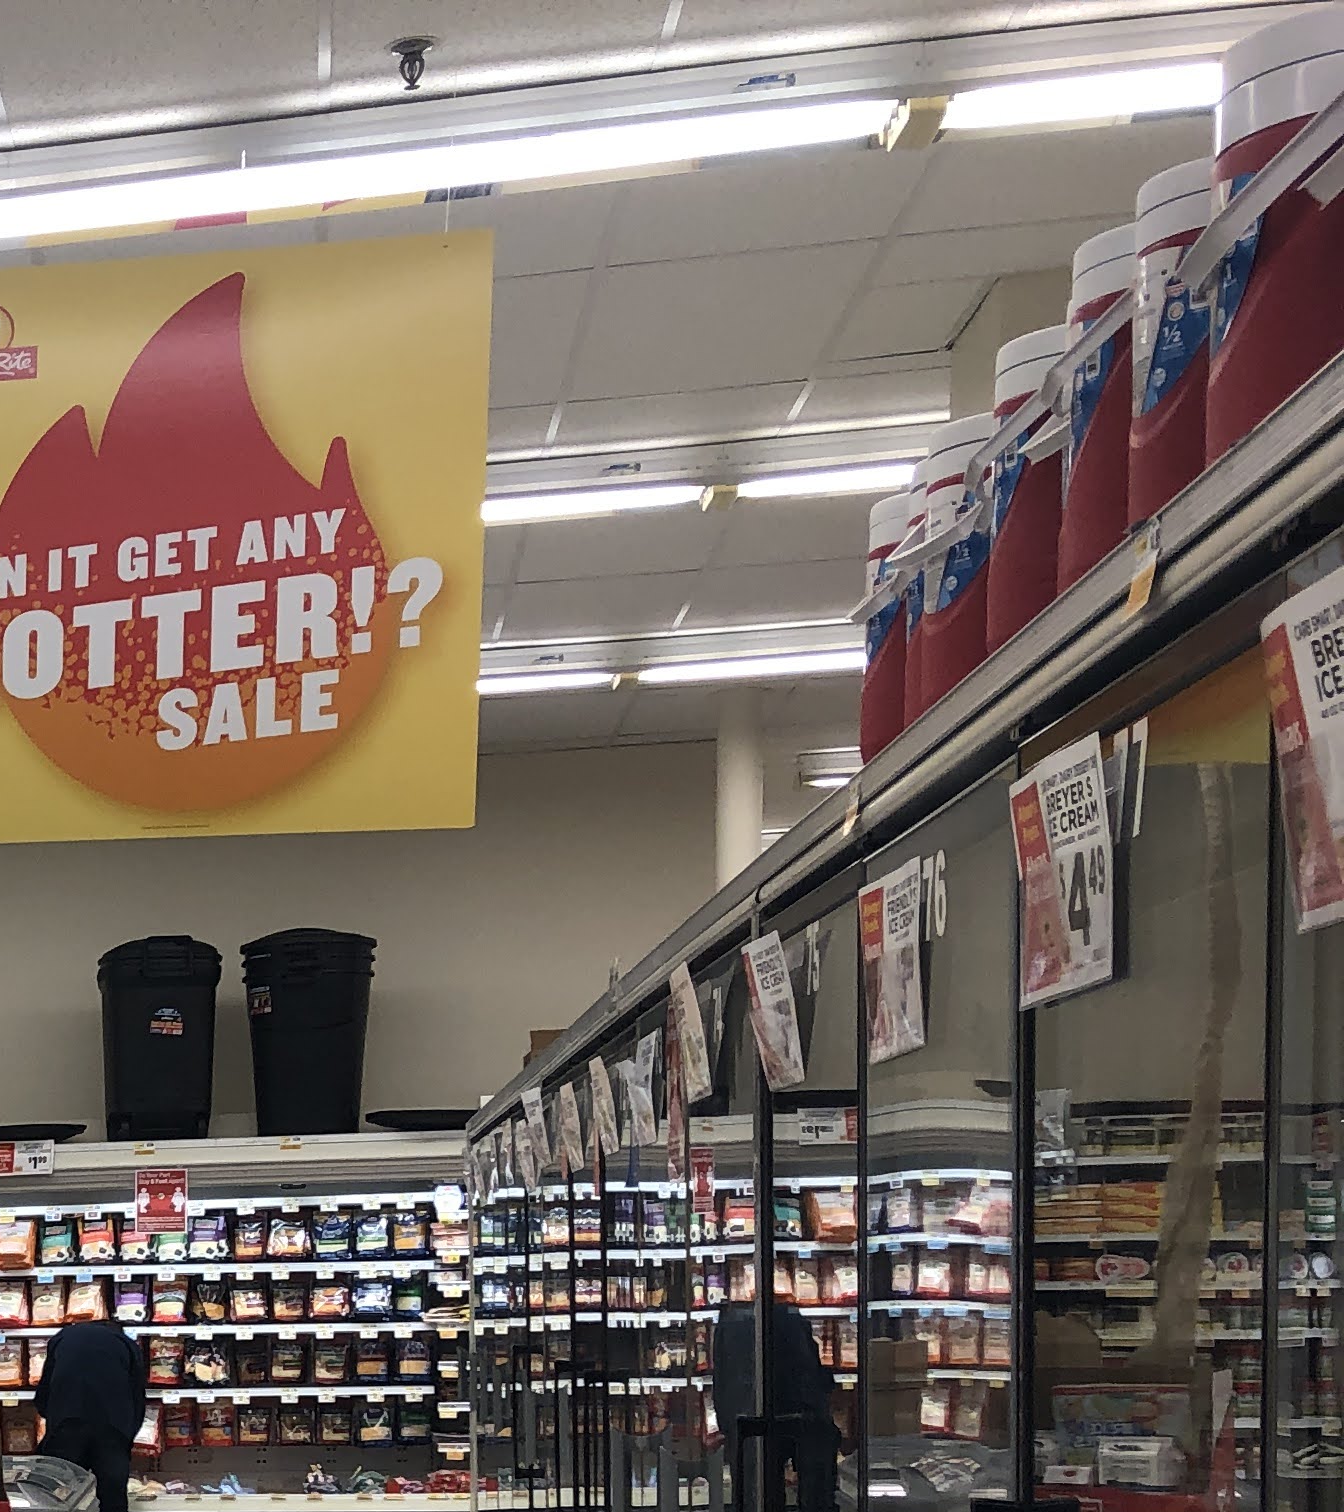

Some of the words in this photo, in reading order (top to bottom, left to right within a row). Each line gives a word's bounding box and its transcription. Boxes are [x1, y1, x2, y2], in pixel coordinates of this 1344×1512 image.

[48, 544, 97, 592] IT
[117, 526, 218, 583] GET
[236, 508, 346, 566] ANY
[156, 670, 340, 751] SALE
[923, 849, 947, 942] 76
